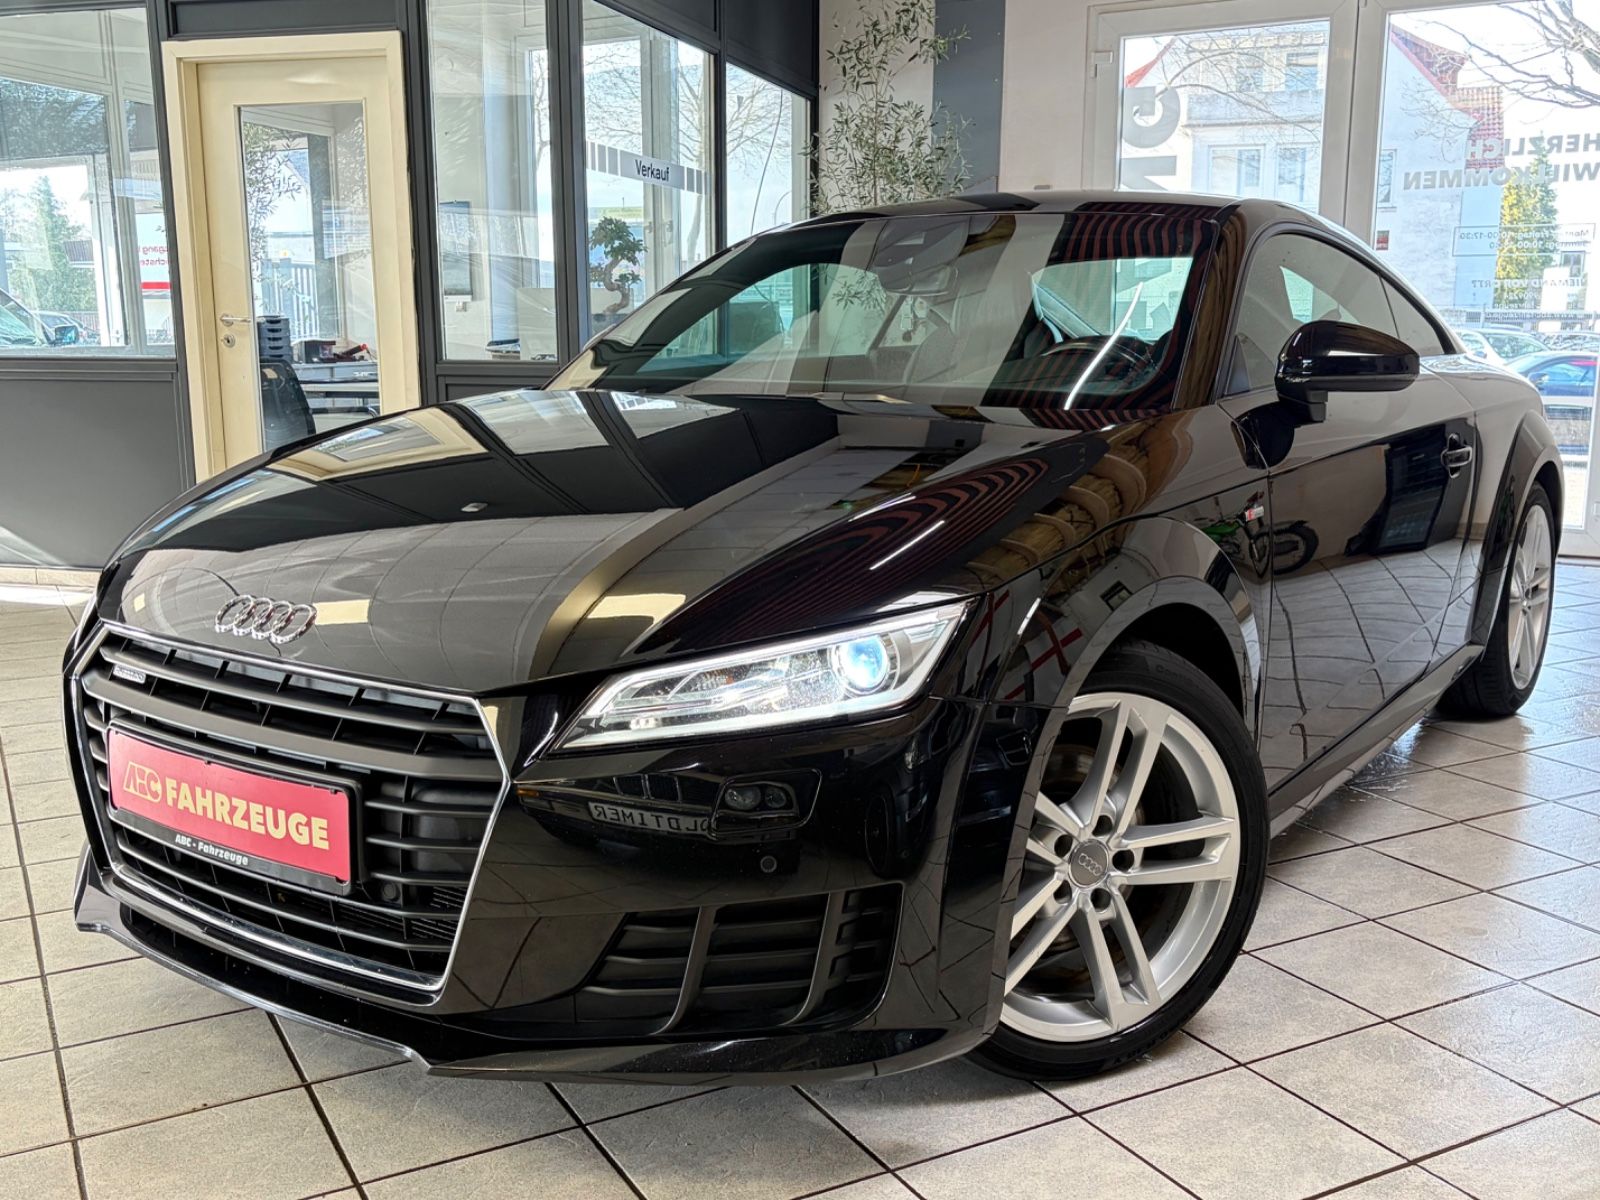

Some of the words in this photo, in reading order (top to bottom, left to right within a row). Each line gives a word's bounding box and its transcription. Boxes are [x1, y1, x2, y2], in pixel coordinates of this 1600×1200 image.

[635, 159, 670, 182] Verkauf
[165, 776, 330, 850] FAHRZEUGE
[175, 833, 192, 848] ABC
[198, 841, 249, 866] Fahrzeuge
